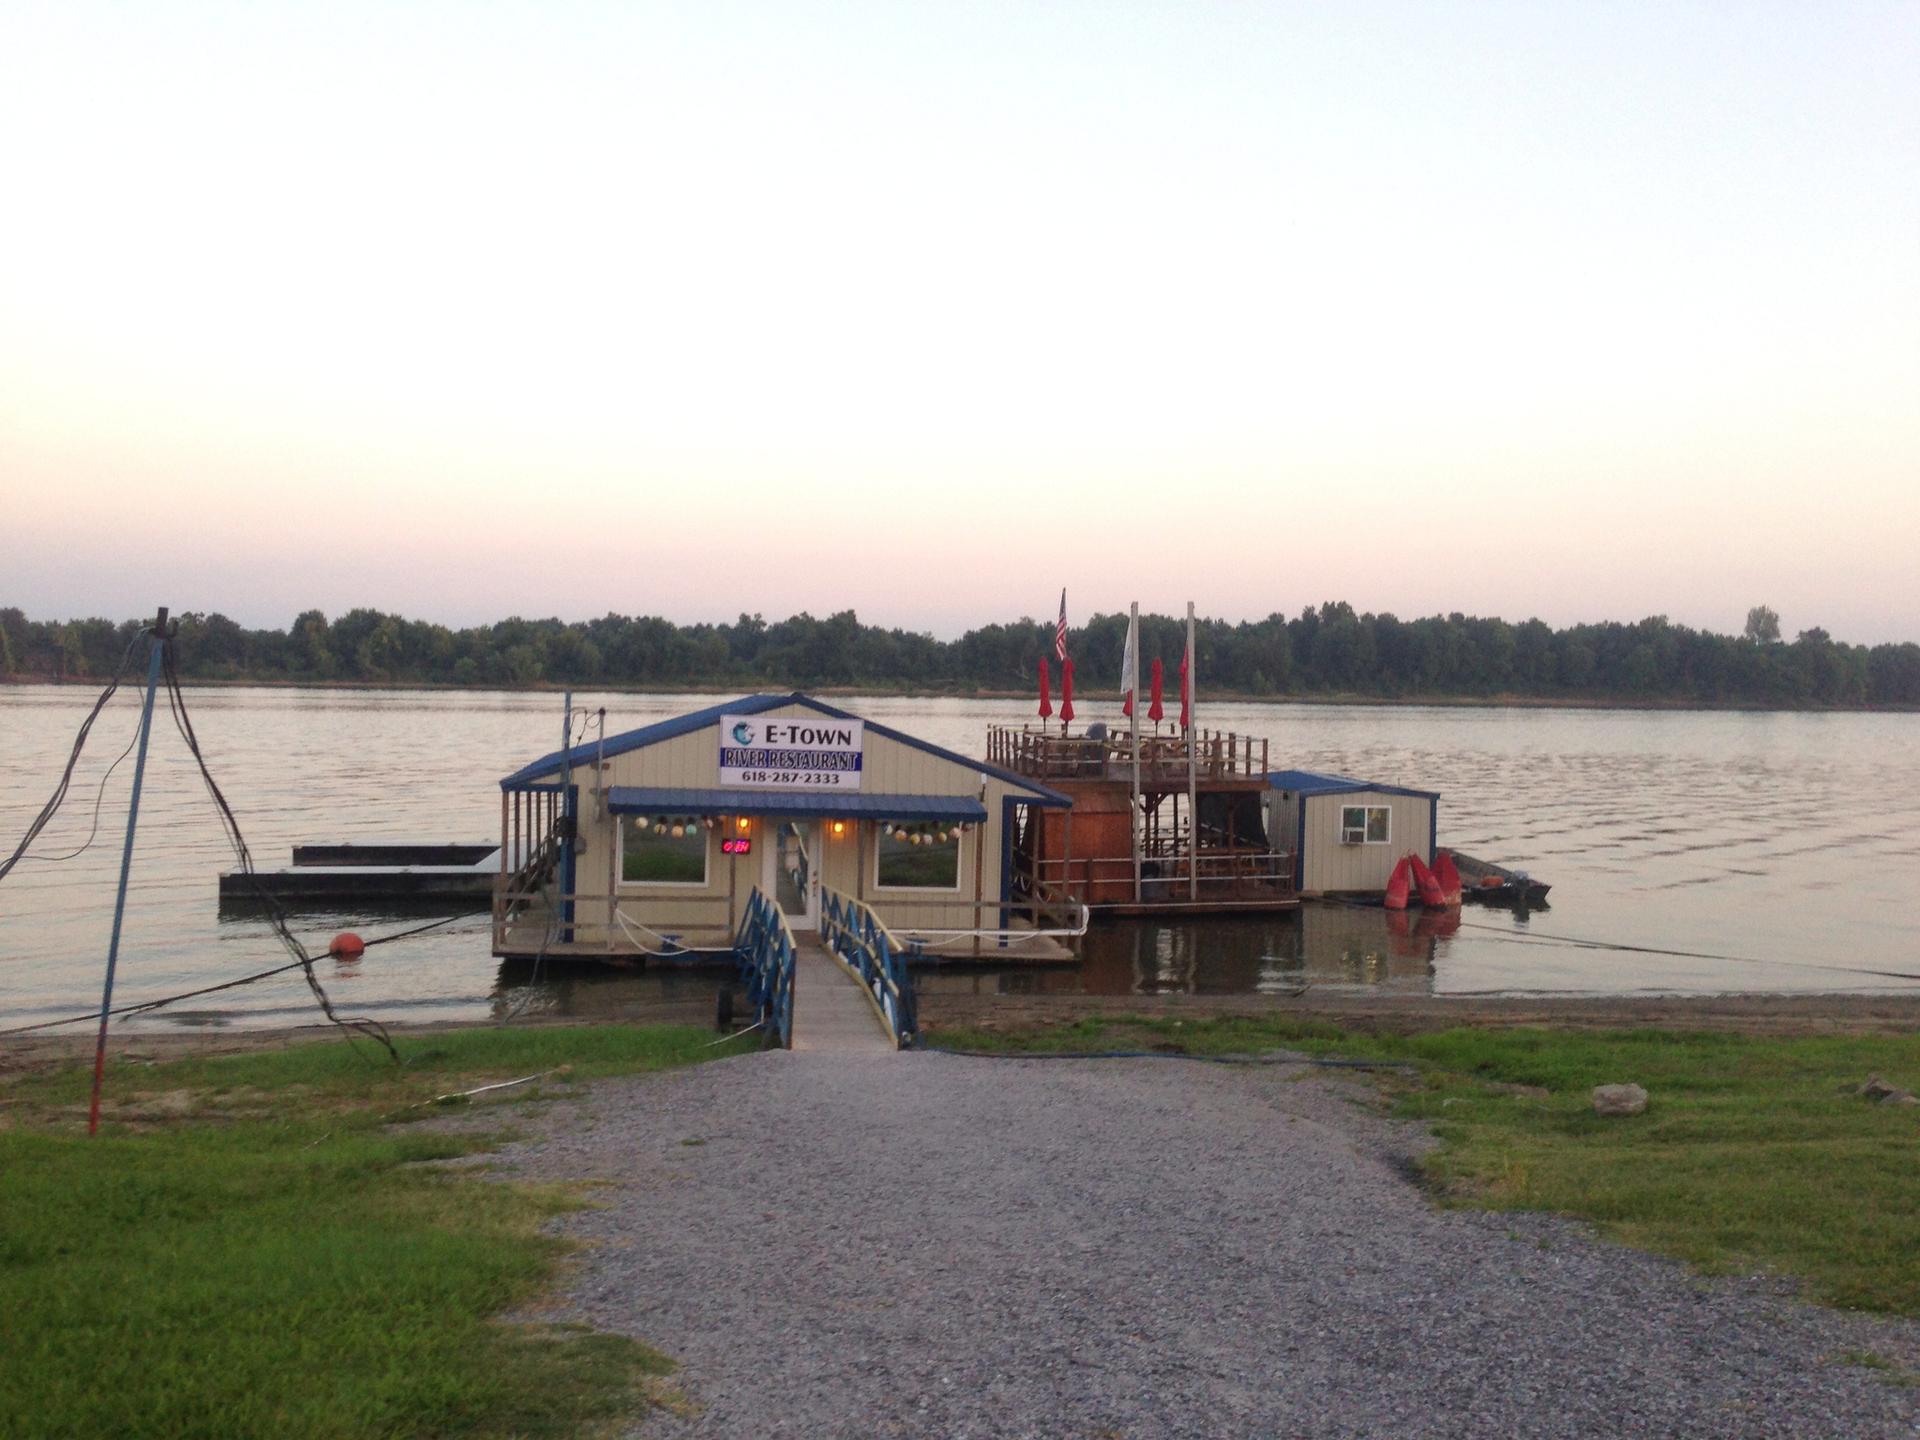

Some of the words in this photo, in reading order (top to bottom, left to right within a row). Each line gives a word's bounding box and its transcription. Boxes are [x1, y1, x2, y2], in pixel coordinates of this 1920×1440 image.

[725, 748, 767, 767] RIVER
[769, 749, 857, 770] RESTAURANT
[741, 771, 840, 785] 618-287-2333
[723, 840, 749, 853] OEN
